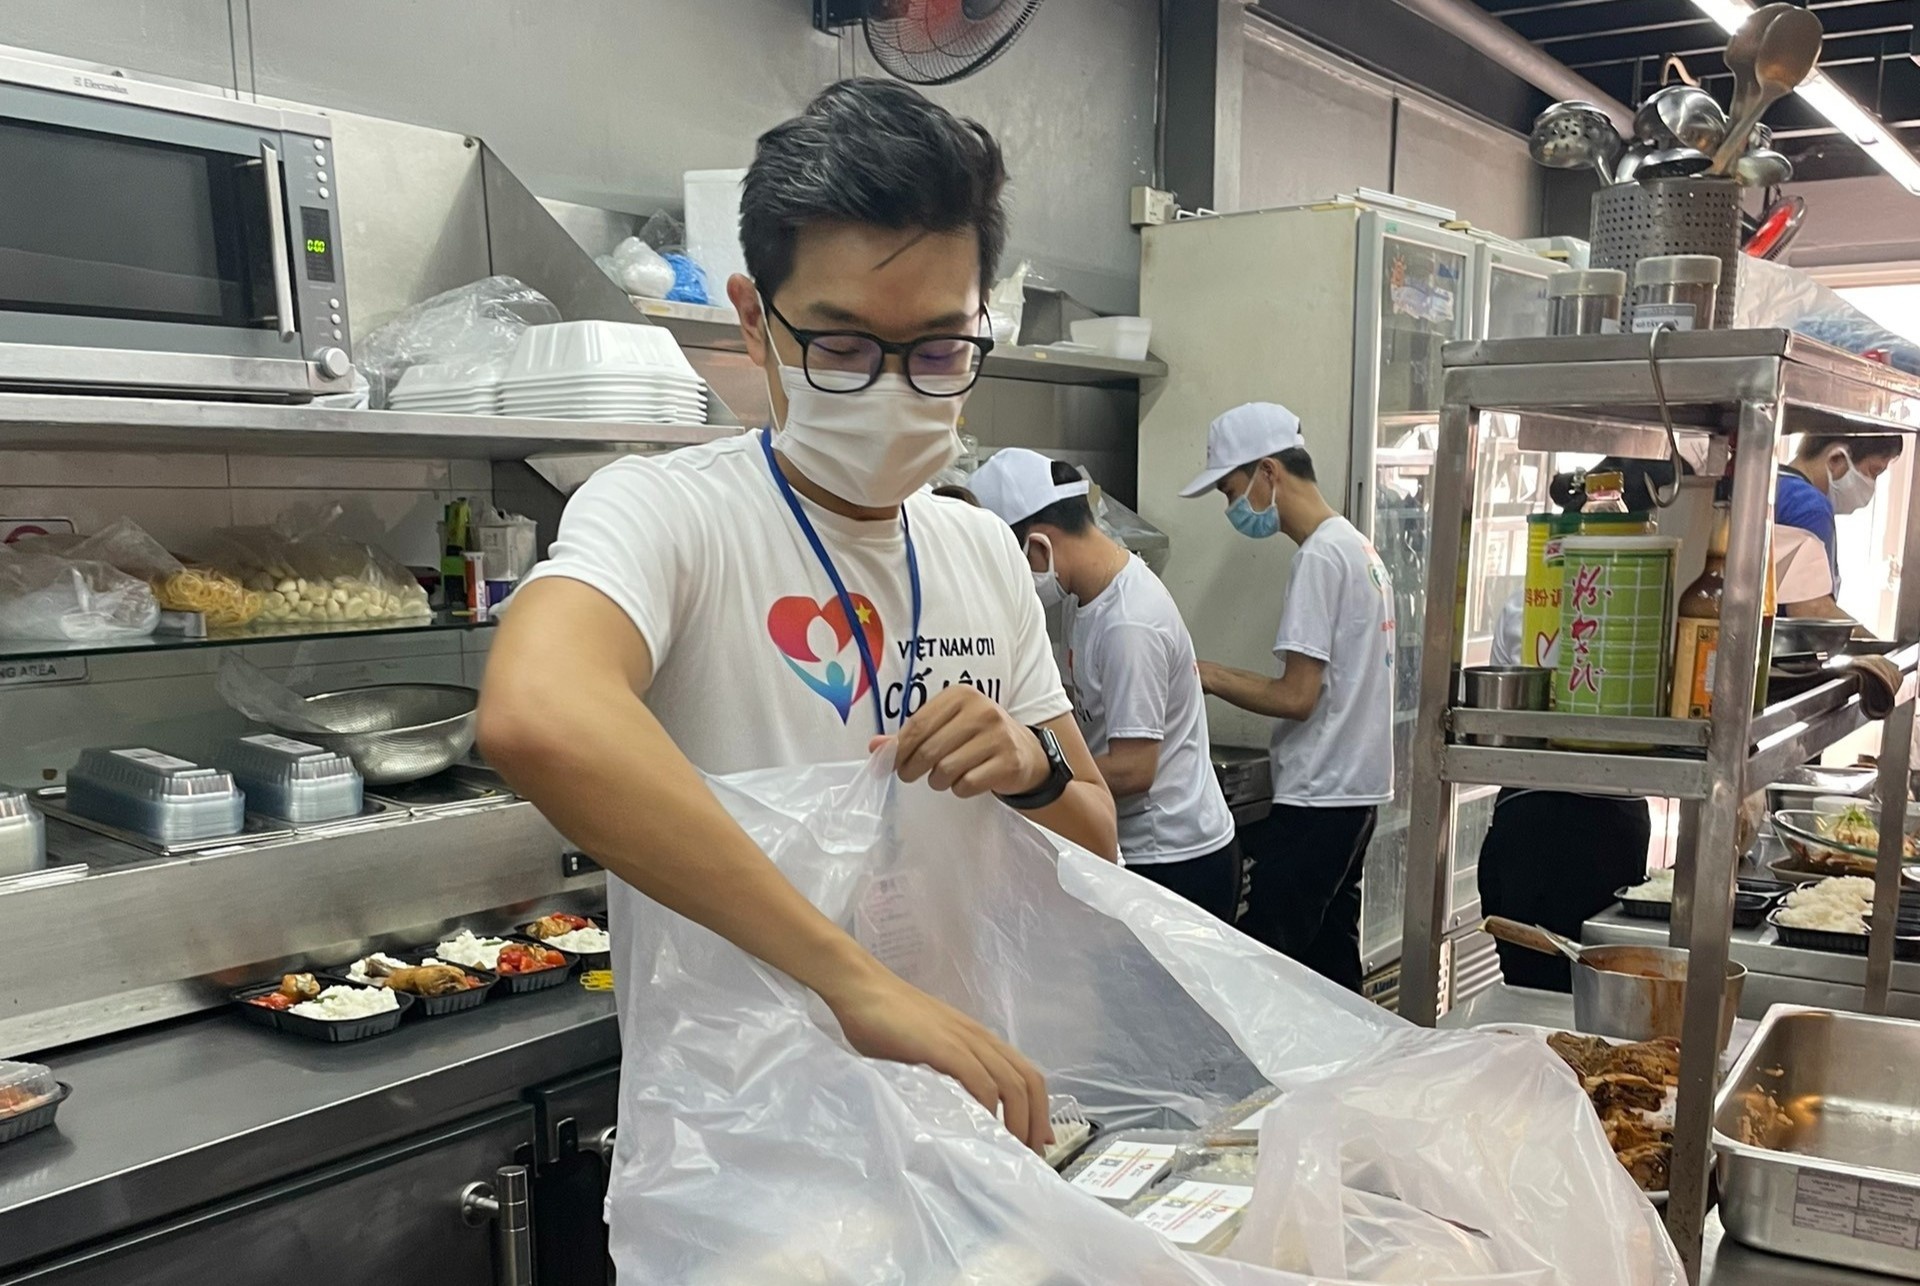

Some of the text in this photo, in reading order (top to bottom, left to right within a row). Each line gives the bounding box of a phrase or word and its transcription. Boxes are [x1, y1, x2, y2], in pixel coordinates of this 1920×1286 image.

[898, 635, 937, 661] VỆT
[940, 637, 973, 657] NAM
[20, 664, 57, 677] AREA
